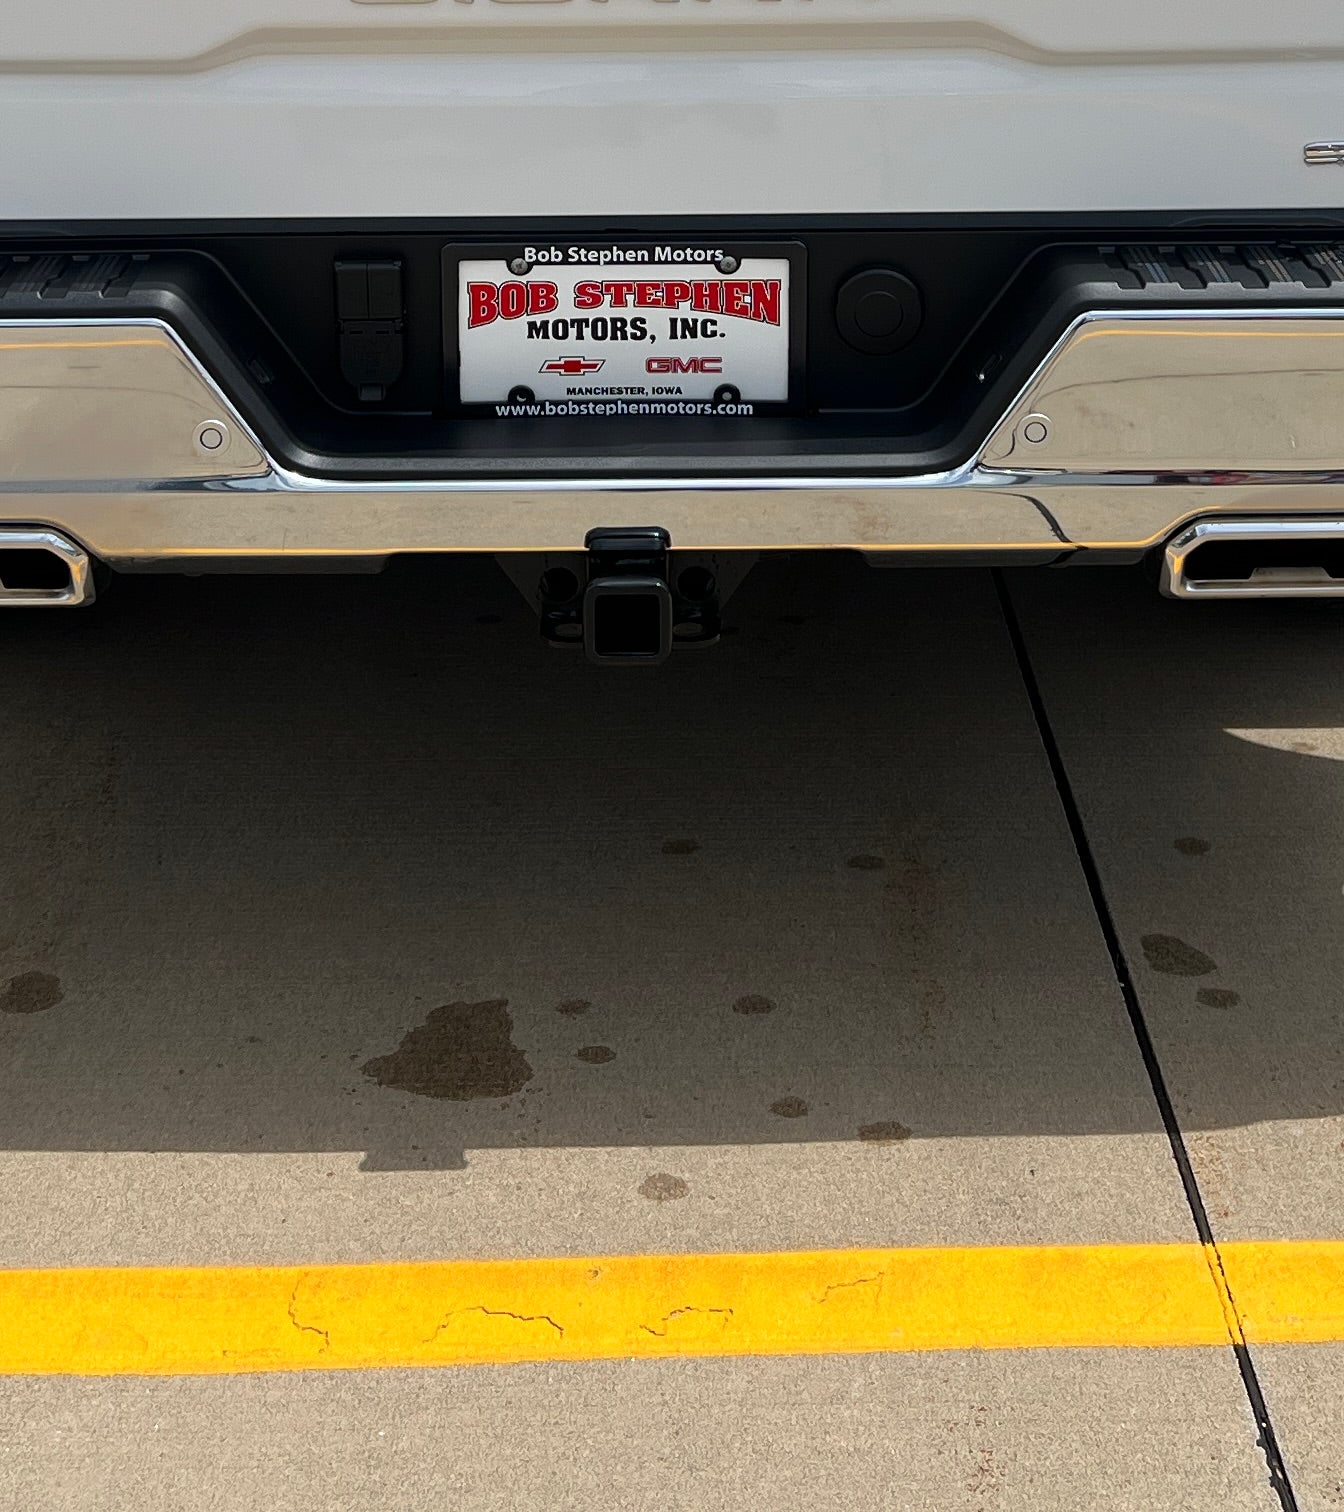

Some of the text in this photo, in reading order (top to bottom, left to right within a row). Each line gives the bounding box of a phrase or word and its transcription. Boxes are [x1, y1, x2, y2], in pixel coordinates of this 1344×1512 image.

[524, 246, 724, 265] Bob Stephen Motors
[467, 278, 782, 329] BOB STEPHEN
[527, 317, 726, 344] MOTORS, INC.
[645, 356, 723, 374] GMC
[566, 386, 683, 397] MANCHESTER, IOWA
[495, 399, 754, 417] www.bobstephenmotors.com
